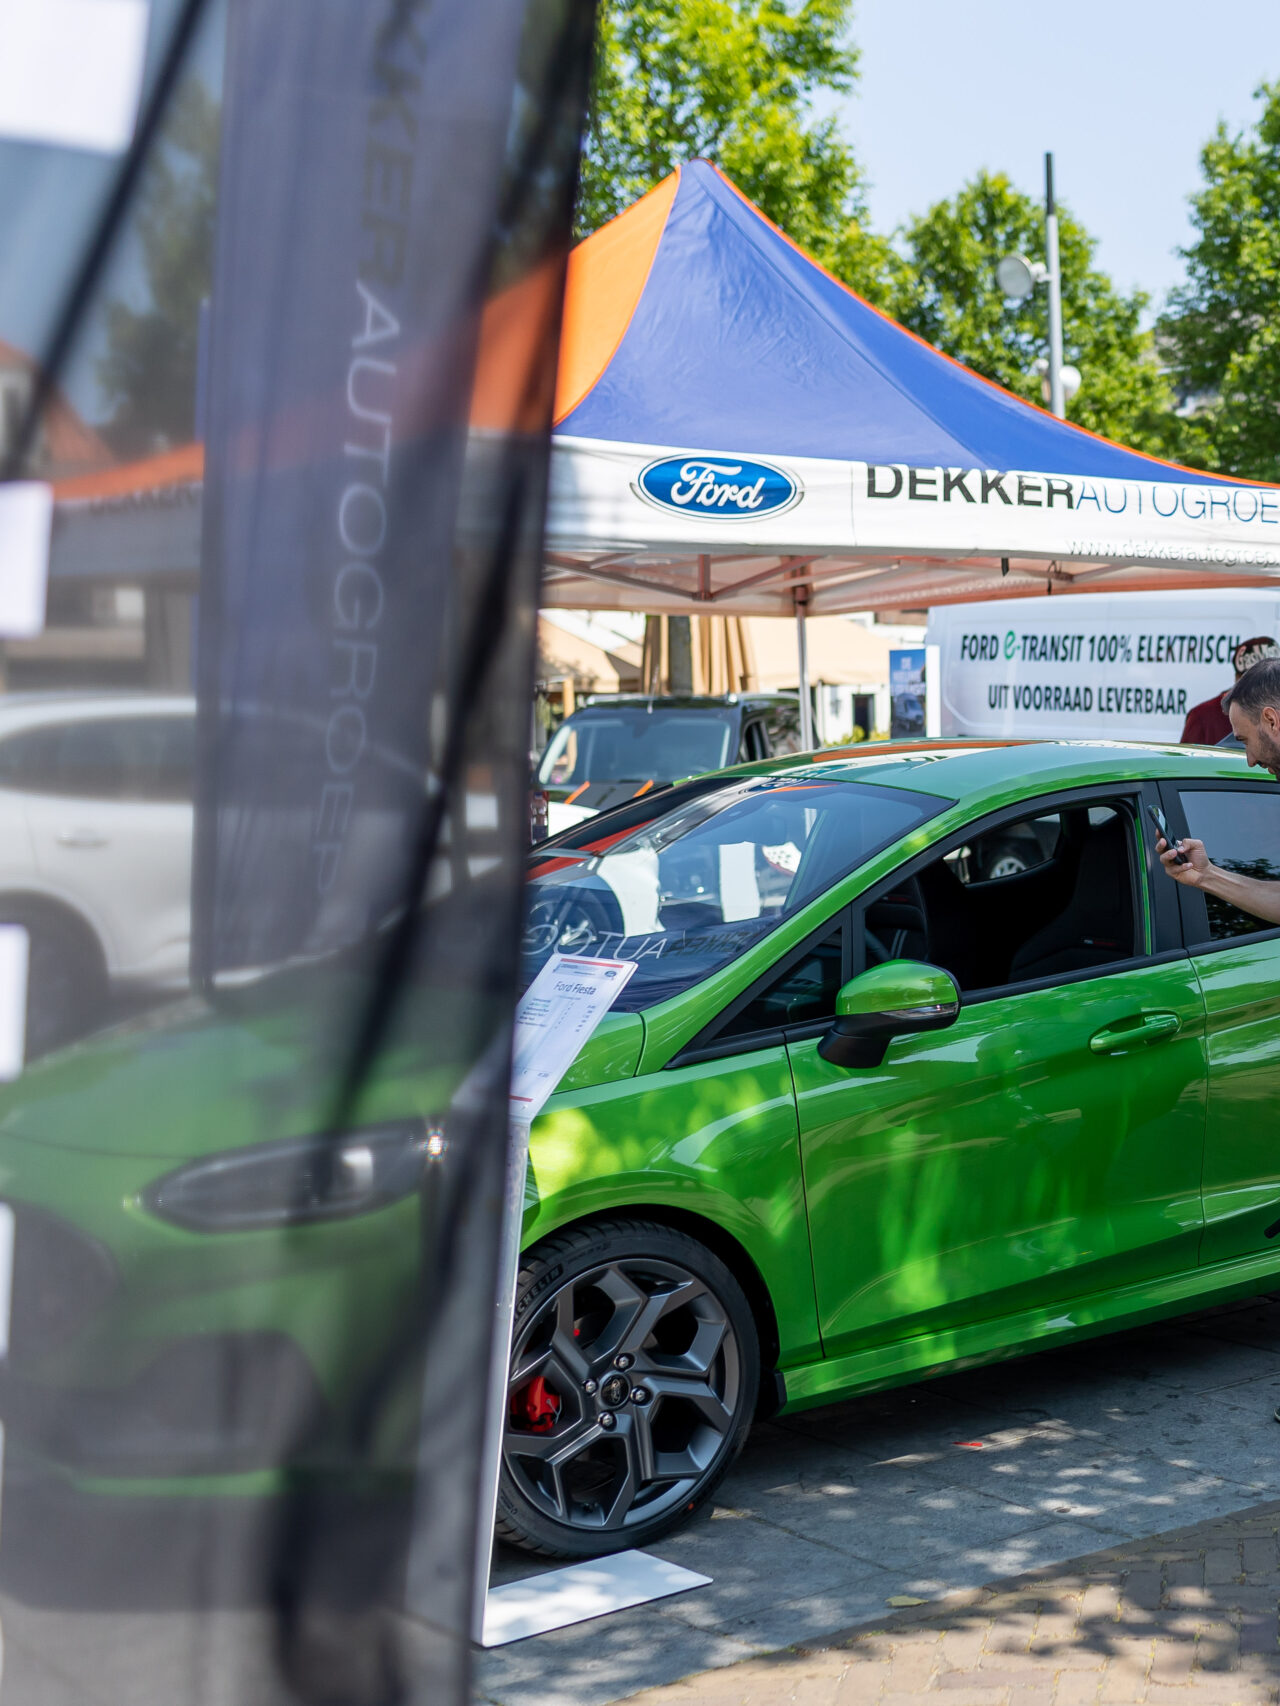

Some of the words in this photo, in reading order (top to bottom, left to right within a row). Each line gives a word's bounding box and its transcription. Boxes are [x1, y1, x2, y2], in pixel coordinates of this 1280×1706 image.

[671, 461, 766, 509] Ford
[960, 635, 999, 661] FORD
[1089, 635, 1132, 663] 100%
[1137, 634, 1240, 665] ELEKTRISCH
[988, 685, 1010, 710] UIT
[1013, 685, 1093, 712] VOORRAAD
[1098, 687, 1187, 715] LEVERBAAR
[553, 980, 571, 993] Ford
[571, 983, 597, 996] Fiesta
